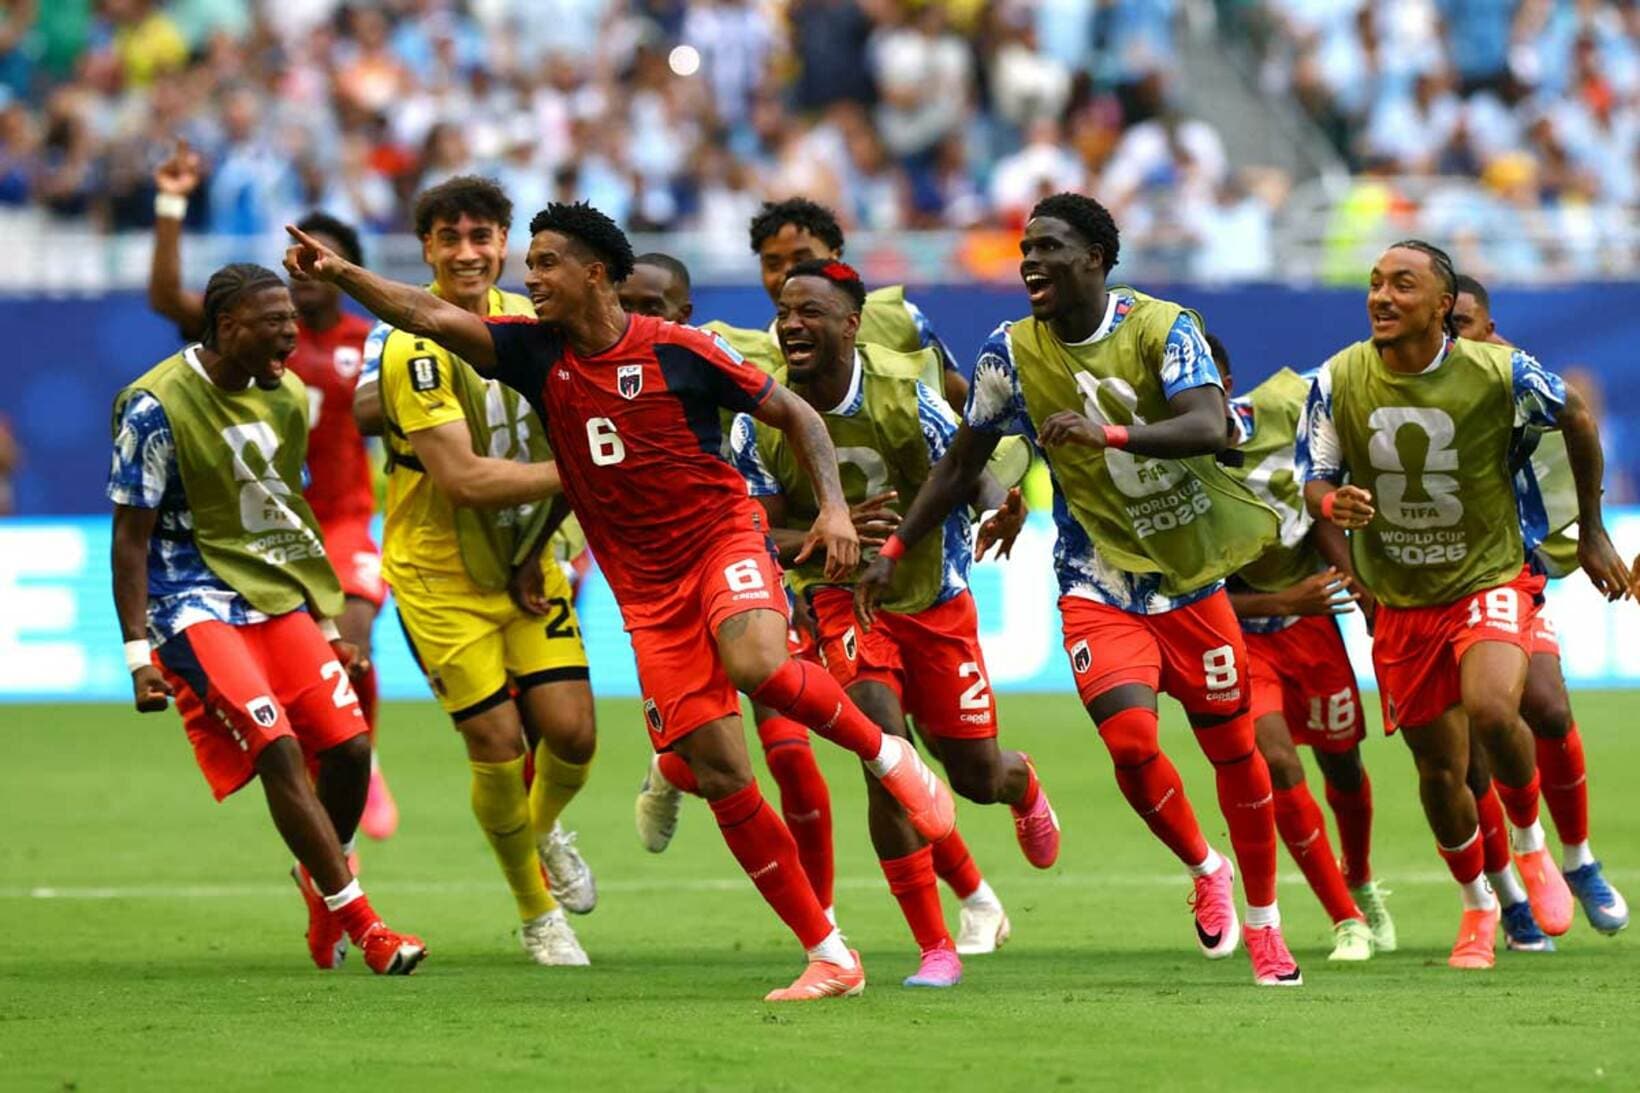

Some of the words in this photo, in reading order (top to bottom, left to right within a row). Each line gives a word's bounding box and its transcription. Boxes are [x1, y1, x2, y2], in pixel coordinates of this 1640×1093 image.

[586, 417, 626, 467] 6
[1137, 463, 1170, 484] FIFA
[1126, 495, 1180, 518] WORLD
[1133, 493, 1213, 539] 2026
[1401, 507, 1440, 519] FIFA
[1380, 530, 1435, 545] WORLD
[1436, 530, 1467, 544] CUP
[1384, 543, 1469, 565] 2026
[723, 558, 766, 593] 6
[545, 597, 582, 640] 2
[1467, 587, 1518, 630] 19
[959, 661, 990, 709] 2
[1203, 645, 1238, 690] 8
[1307, 687, 1355, 732] 16
